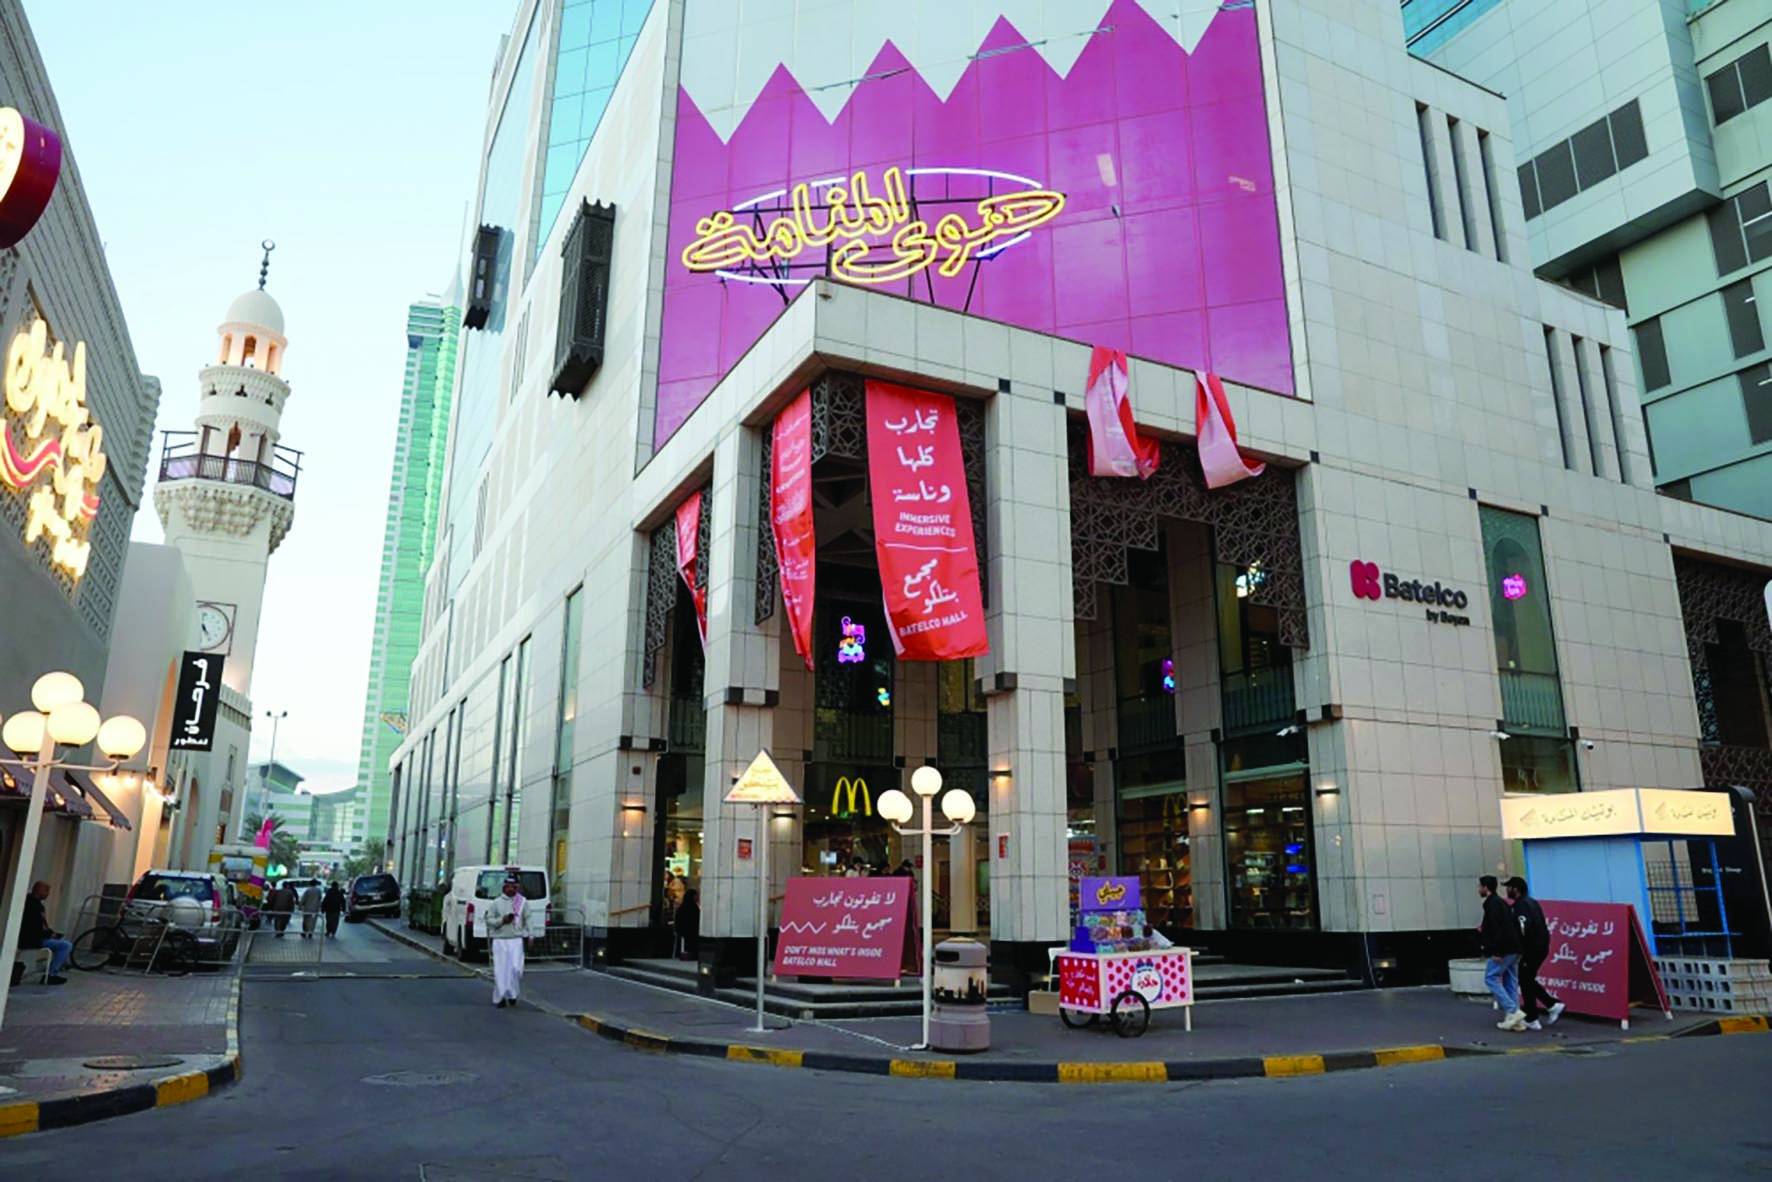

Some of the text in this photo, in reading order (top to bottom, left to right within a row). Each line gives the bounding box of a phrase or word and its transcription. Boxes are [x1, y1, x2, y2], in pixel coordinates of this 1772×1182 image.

[682, 167, 908, 270] المنامة
[884, 409, 938, 436] تجارب
[896, 446, 934, 473] كلها
[892, 479, 951, 503] وناسة
[895, 522, 956, 538] EXPERIENCES
[899, 511, 951, 524] IMMERSIVE
[904, 558, 938, 598] مجمع
[1383, 572, 1469, 609] Batelco
[922, 580, 959, 614] بتلكو
[899, 610, 968, 637] BATELCO MALL
[1426, 609, 1439, 624] by
[184, 658, 210, 735] فرحان
[812, 890, 896, 909] لا تفوتون تجارب
[832, 913, 893, 939] مجمع بتلكو
[1560, 919, 1598, 938] تفوتون
[1602, 921, 1614, 935] لا
[784, 945, 808, 955] DON'T
[1550, 943, 1614, 972] مجمع بتلكو
